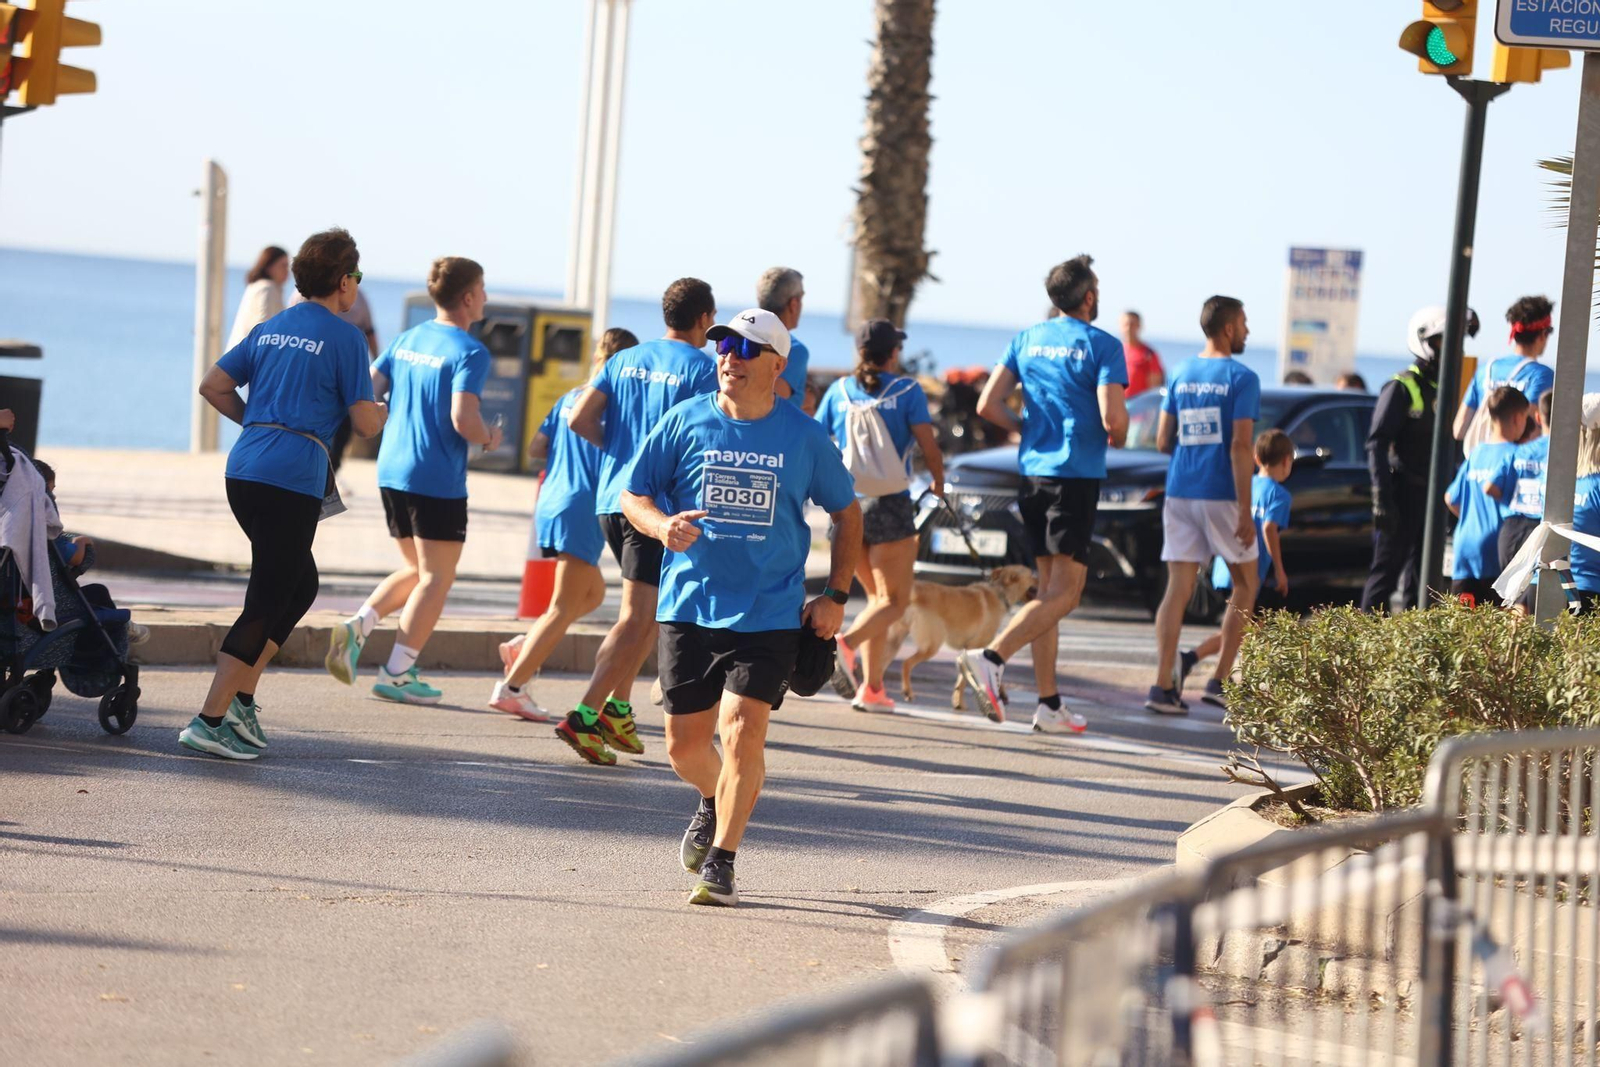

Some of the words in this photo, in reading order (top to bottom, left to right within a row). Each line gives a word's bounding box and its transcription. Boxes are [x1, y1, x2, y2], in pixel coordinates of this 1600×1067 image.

[1550, 18, 1600, 34] REGU
[257, 333, 325, 356] mayoral
[1027, 344, 1089, 361] mayoral
[394, 348, 446, 369] mayoral
[620, 366, 685, 388] mayoral
[1176, 382, 1230, 397] mayoral
[704, 449, 784, 468] mayoral
[711, 487, 766, 506] 2030
